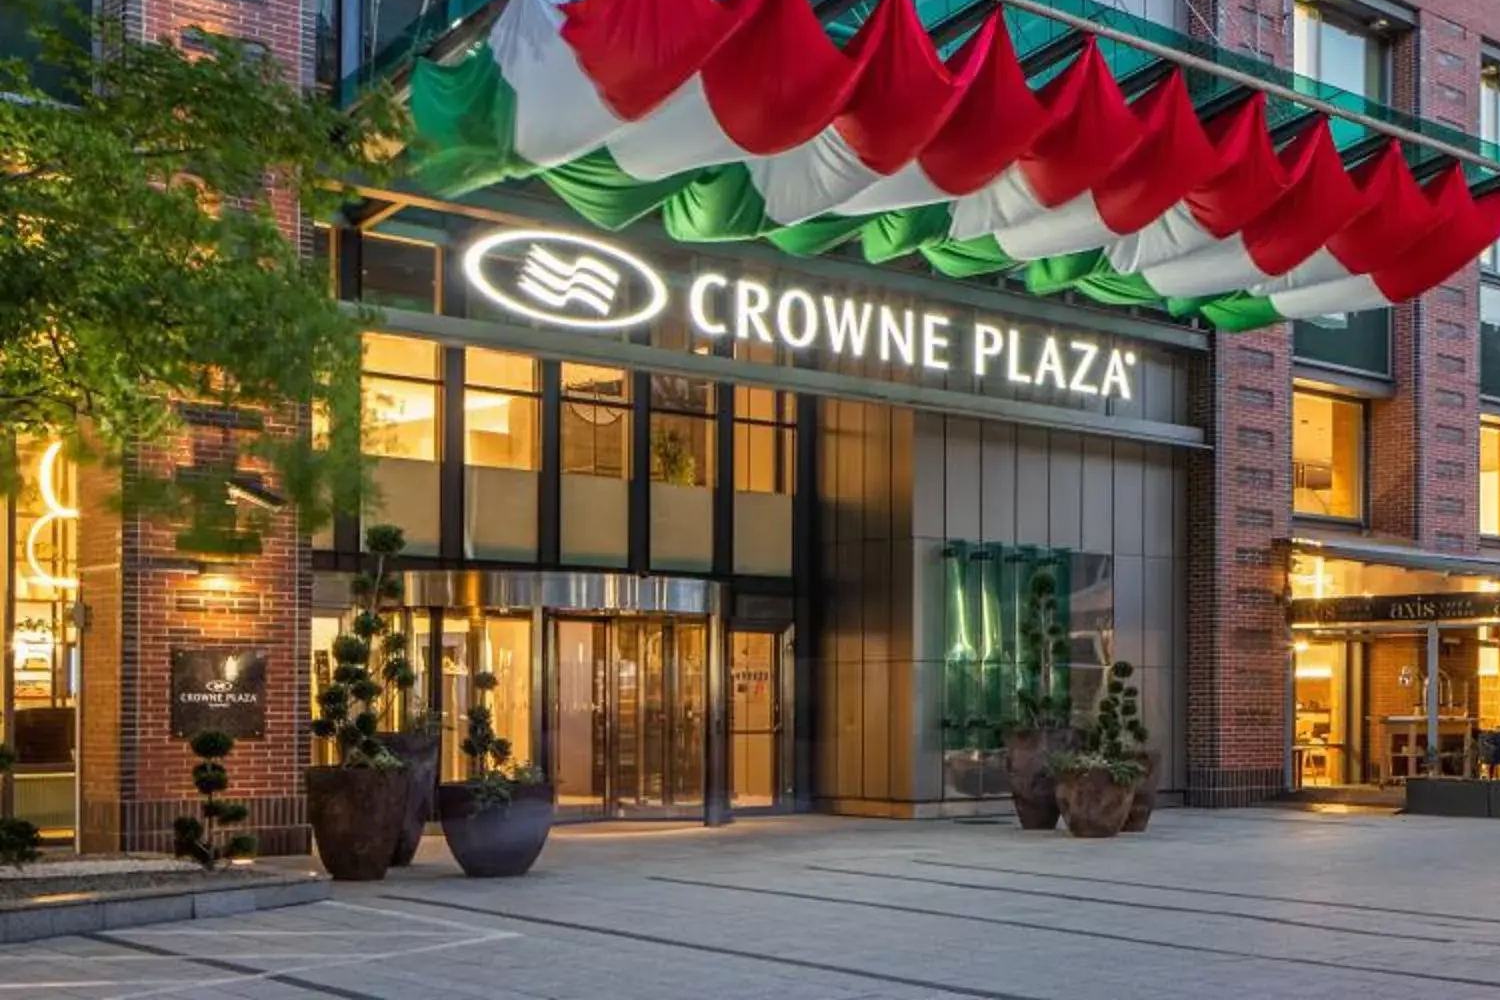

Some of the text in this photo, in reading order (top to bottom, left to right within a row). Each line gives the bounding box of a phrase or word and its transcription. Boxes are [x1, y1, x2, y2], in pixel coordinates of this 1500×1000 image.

[688, 272, 1134, 400] CROWNE PLAZA
[1390, 596, 1436, 619] axis
[180, 692, 257, 703] CROWNE PLAZA
